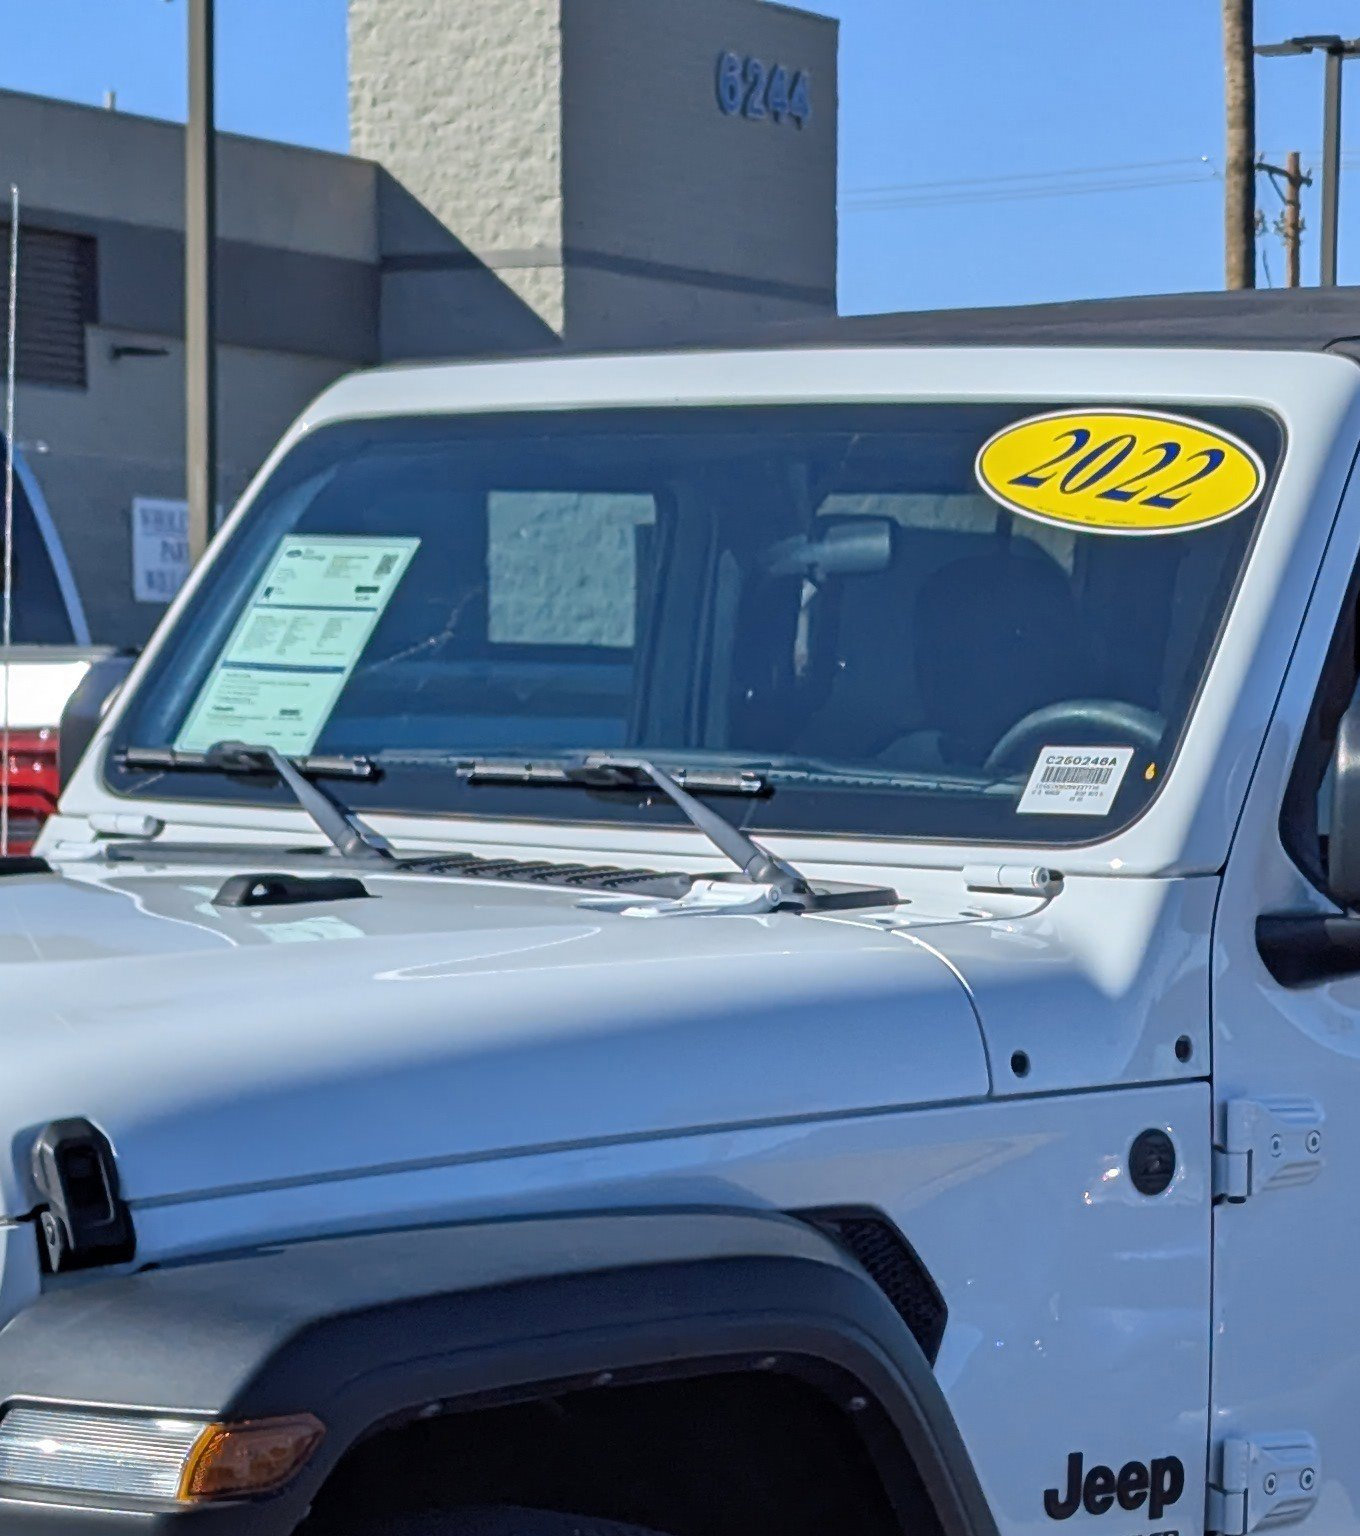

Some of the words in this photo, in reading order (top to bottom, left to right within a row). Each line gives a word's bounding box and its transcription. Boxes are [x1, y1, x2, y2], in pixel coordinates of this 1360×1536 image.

[717, 51, 812, 129] 6244
[1006, 428, 1226, 510] 2022
[1043, 1452, 1186, 1521] Jeep
